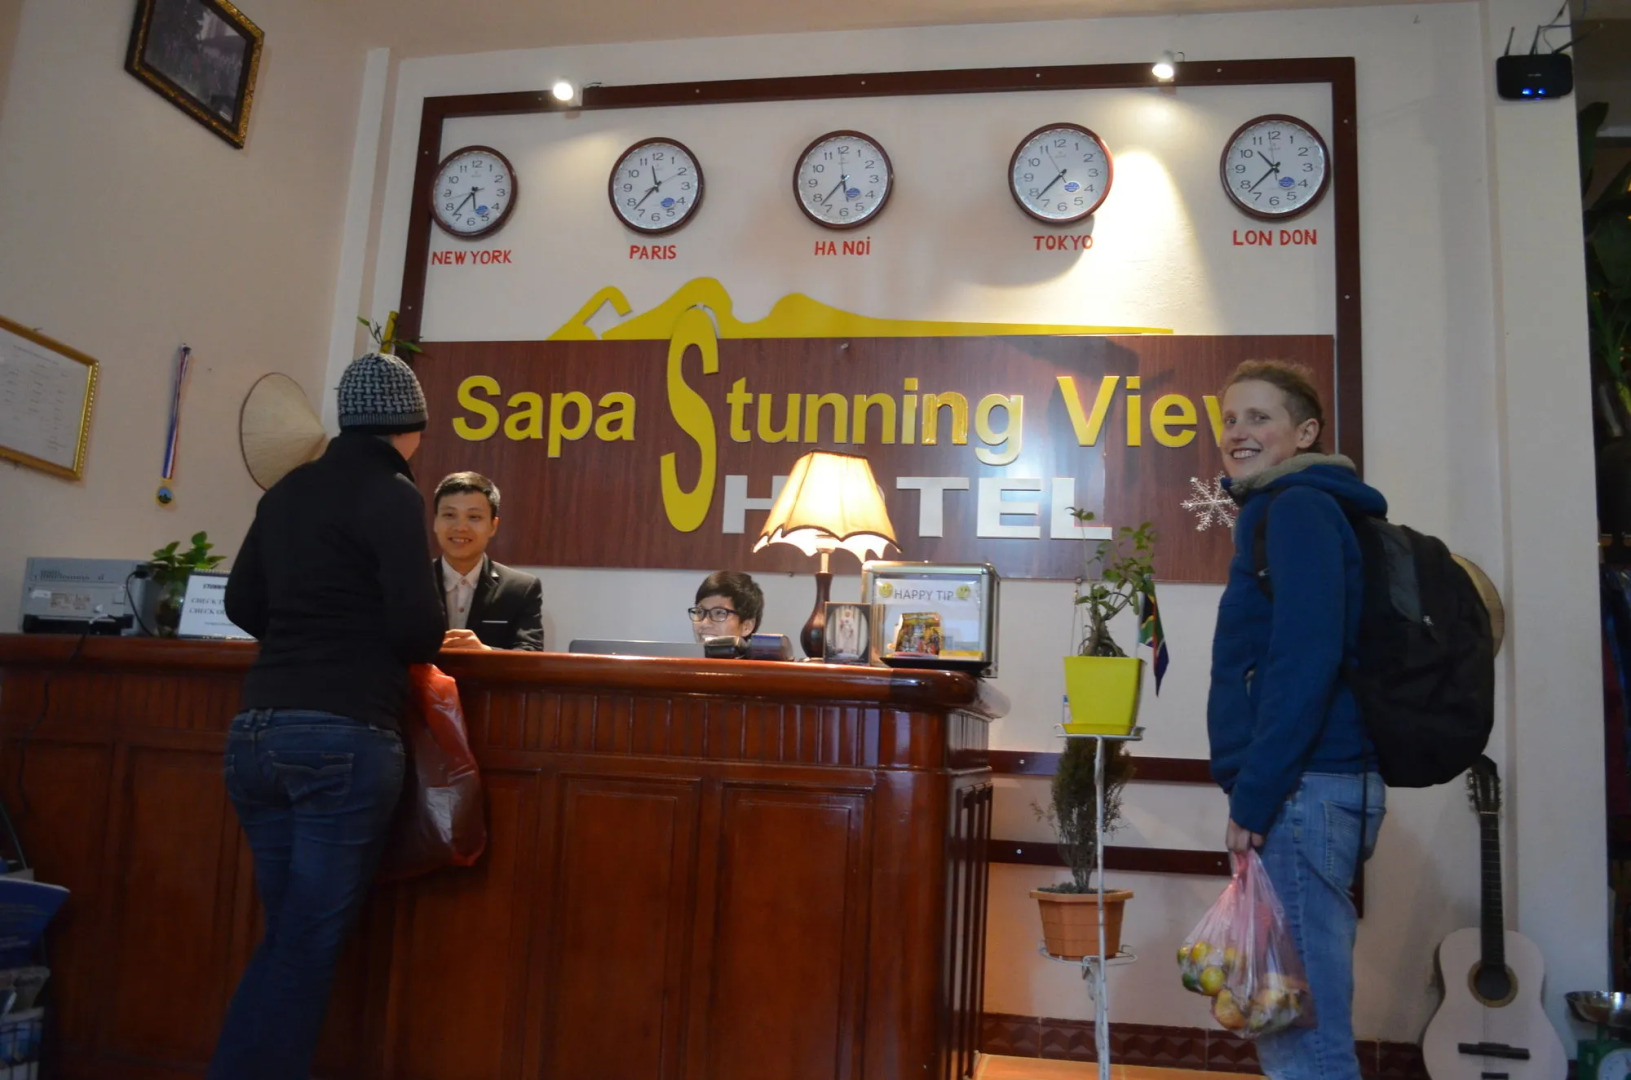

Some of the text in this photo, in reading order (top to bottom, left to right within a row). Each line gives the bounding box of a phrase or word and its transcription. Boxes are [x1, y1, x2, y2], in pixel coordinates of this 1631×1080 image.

[1268, 131, 1281, 140] 12
[1054, 139, 1066, 148] 12
[1253, 136, 1262, 145] 11
[838, 146, 849, 154] 12
[1040, 145, 1049, 154] 11
[1240, 149, 1253, 159] 10
[1298, 147, 1309, 156] 2
[652, 152, 664, 161] 12
[824, 152, 833, 160] 11
[1083, 153, 1094, 163] 2
[472, 160, 483, 168] 12
[640, 158, 648, 166] 11
[865, 160, 875, 169] 2
[1028, 158, 1040, 167] 10
[460, 165, 467, 173] 11
[678, 168, 687, 176] 2
[813, 164, 825, 173] 10
[1235, 164, 1246, 174] 9
[1302, 163, 1313, 172] 3
[628, 169, 639, 178] 10
[1088, 168, 1099, 177] 3
[448, 176, 459, 184] 10
[494, 175, 504, 183] 2
[869, 175, 879, 183] 3
[1024, 173, 1034, 182] 9
[681, 182, 690, 190] 3
[808, 179, 818, 188] 9
[1240, 180, 1251, 189] 8
[1298, 179, 1308, 187] 4
[496, 188, 506, 197] 3
[623, 184, 633, 192] 9
[1029, 188, 1040, 197] 8
[1084, 184, 1095, 192] 4
[813, 193, 823, 202] 8
[865, 190, 875, 199] 4
[1253, 192, 1262, 201] 7
[1287, 191, 1297, 201] 5
[627, 198, 637, 207] 8
[676, 197, 686, 205] 4
[1041, 199, 1050, 207] 7
[1074, 197, 1084, 206] 5
[1269, 196, 1280, 206] 6
[445, 203, 454, 211] 8
[491, 203, 499, 211] 4
[824, 204, 833, 213] 7
[855, 202, 864, 211] 5
[1057, 202, 1068, 211] 6
[638, 209, 646, 217] 7
[651, 213, 660, 221] 6
[666, 208, 675, 217] 5
[839, 208, 849, 217] 6
[467, 217, 476, 226] 6
[1232, 229, 1317, 246] LON DON
[1033, 235, 1093, 251] TOKYO
[629, 245, 677, 260] PARIS
[814, 241, 837, 256] HA
[431, 250, 512, 265] NEW YORK
[452, 375, 636, 458] Sapa
[660, 308, 1024, 532] Stunning
[722, 475, 1113, 541] HTEL
[894, 589, 954, 600] HAPPY TIP
